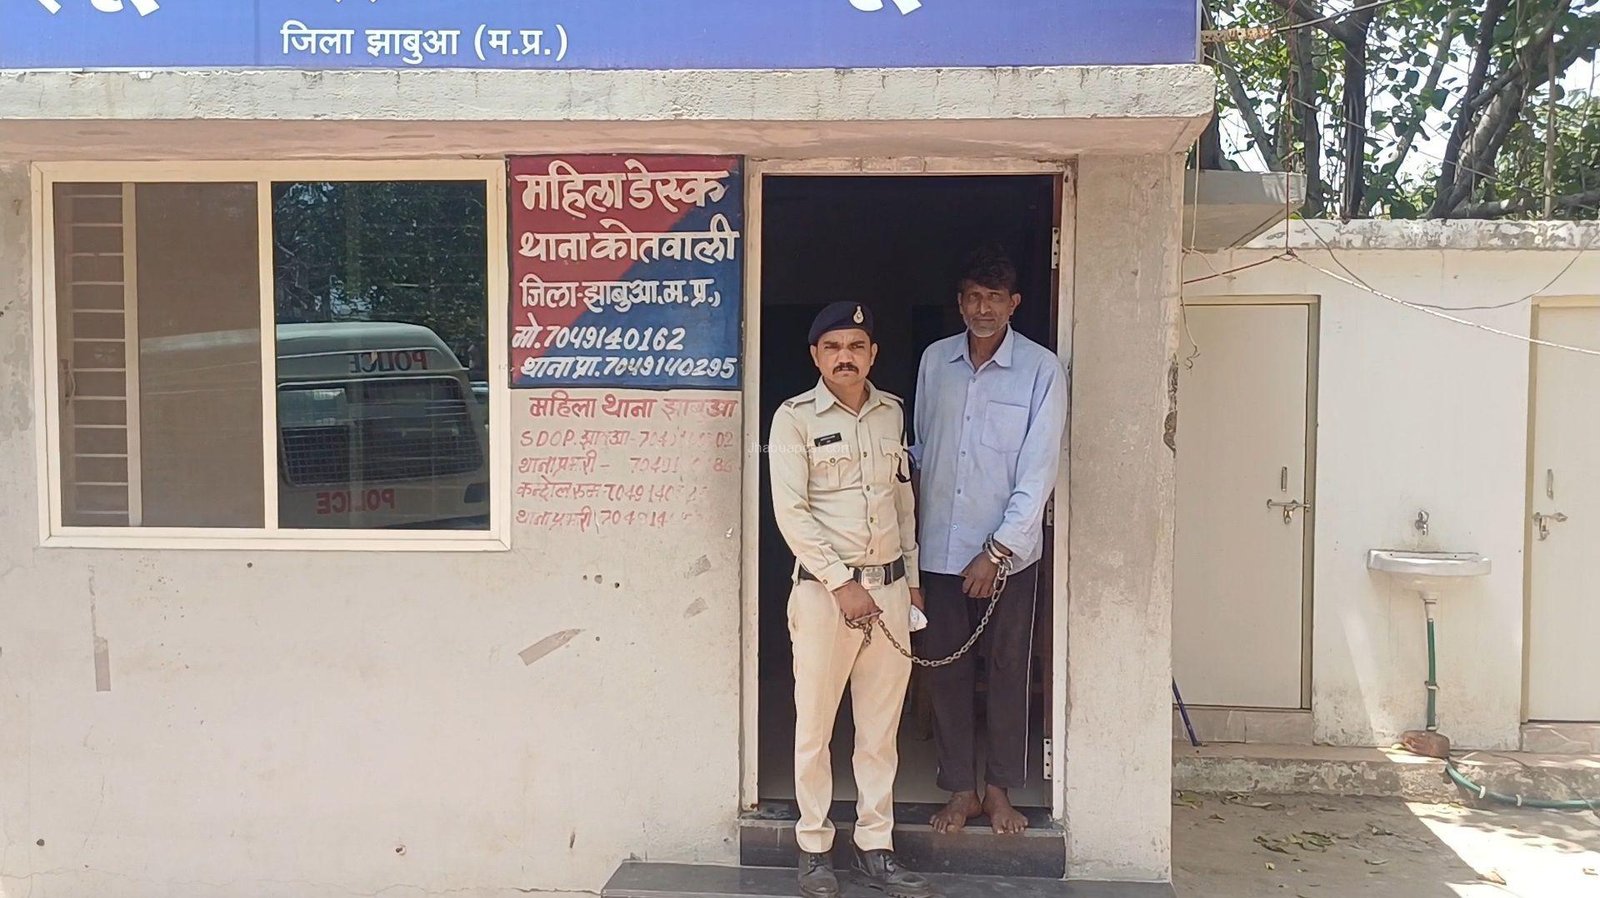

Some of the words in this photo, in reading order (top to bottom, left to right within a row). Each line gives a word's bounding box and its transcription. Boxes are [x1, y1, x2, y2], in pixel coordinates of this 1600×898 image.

[280, 19, 355, 55] जिला
[366, 29, 461, 65] झाबुआ
[474, 24, 569, 62] (म.प्र.)
[515, 159, 628, 218] महिला
[625, 159, 730, 212] डेस्क
[518, 231, 590, 262] थाना
[591, 213, 740, 264] कोतवाली
[529, 390, 596, 418] महिला
[601, 394, 658, 419] थाना
